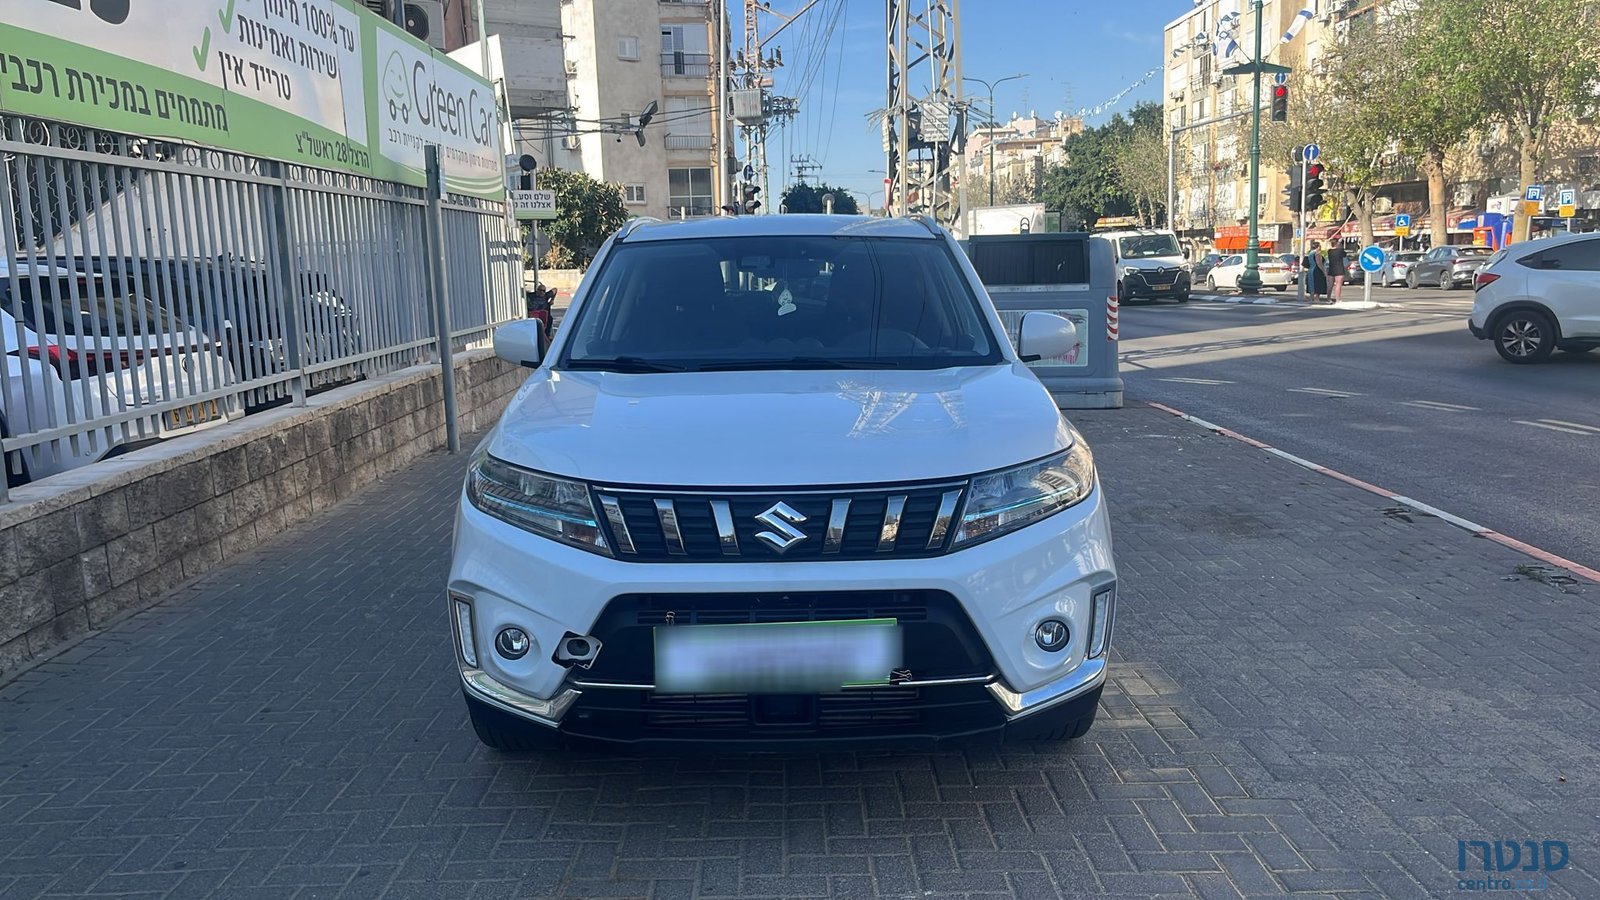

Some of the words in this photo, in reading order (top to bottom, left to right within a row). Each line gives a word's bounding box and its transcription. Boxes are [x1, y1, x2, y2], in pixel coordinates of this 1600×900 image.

[237, 14, 297, 63] ואמינות
[303, 2, 338, 44] 100%
[338, 25, 355, 53] עד
[218, 51, 247, 91] אין
[299, 41, 337, 79] שירות
[65, 68, 151, 116] במכירת
[249, 62, 292, 101] טרייד
[155, 89, 229, 132] מתמחים
[413, 60, 468, 140] Green
[468, 89, 493, 149] Car
[336, 141, 348, 163] 28
[388, 128, 402, 145] רכב
[348, 143, 370, 169] הרצל
[520, 201, 529, 209] זה
[531, 200, 552, 209] אצלנו
[534, 192, 551, 201] שלם
